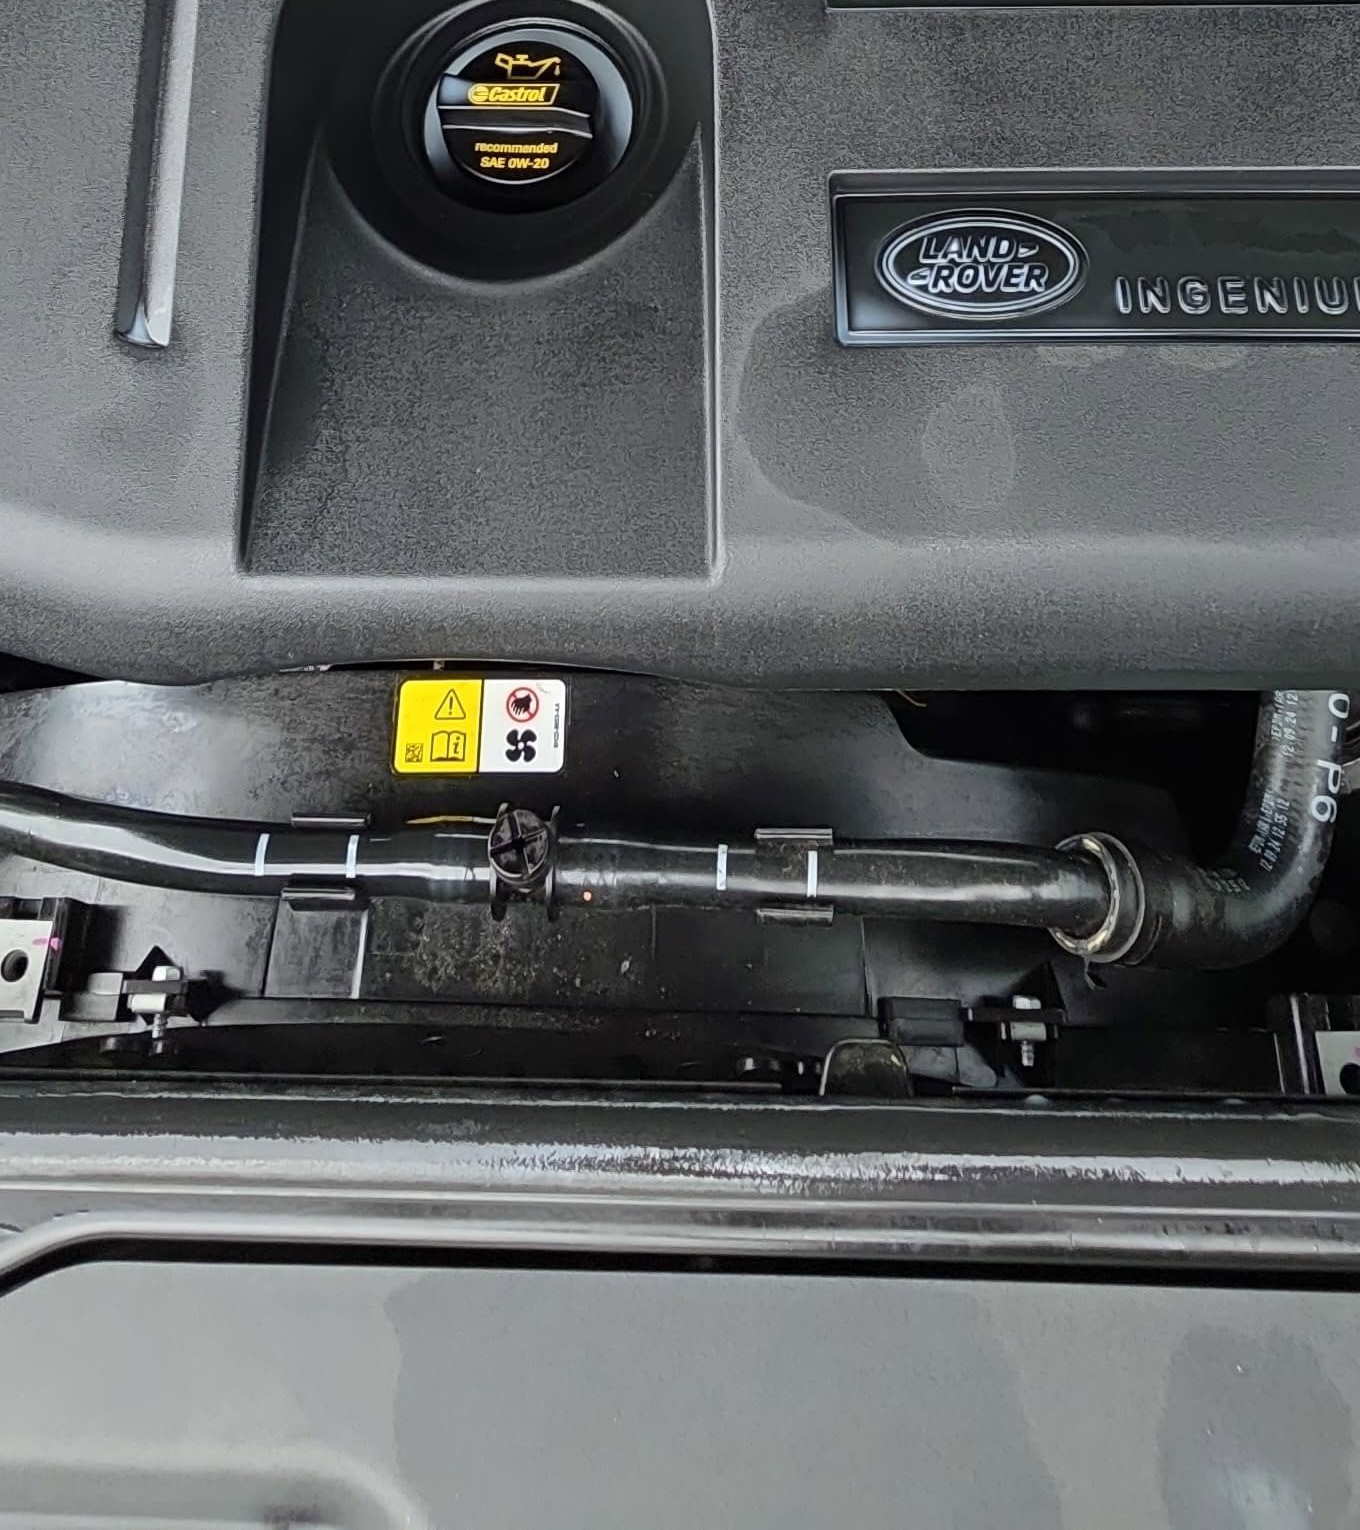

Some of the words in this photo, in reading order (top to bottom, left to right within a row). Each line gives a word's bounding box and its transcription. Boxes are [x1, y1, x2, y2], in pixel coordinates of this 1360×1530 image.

[488, 86, 547, 102] Castrol
[474, 142, 559, 154] recommended
[480, 156, 506, 168] SAE
[507, 157, 550, 169] 0W-20
[919, 235, 1017, 263] LAND
[928, 263, 1049, 294] ROVER
